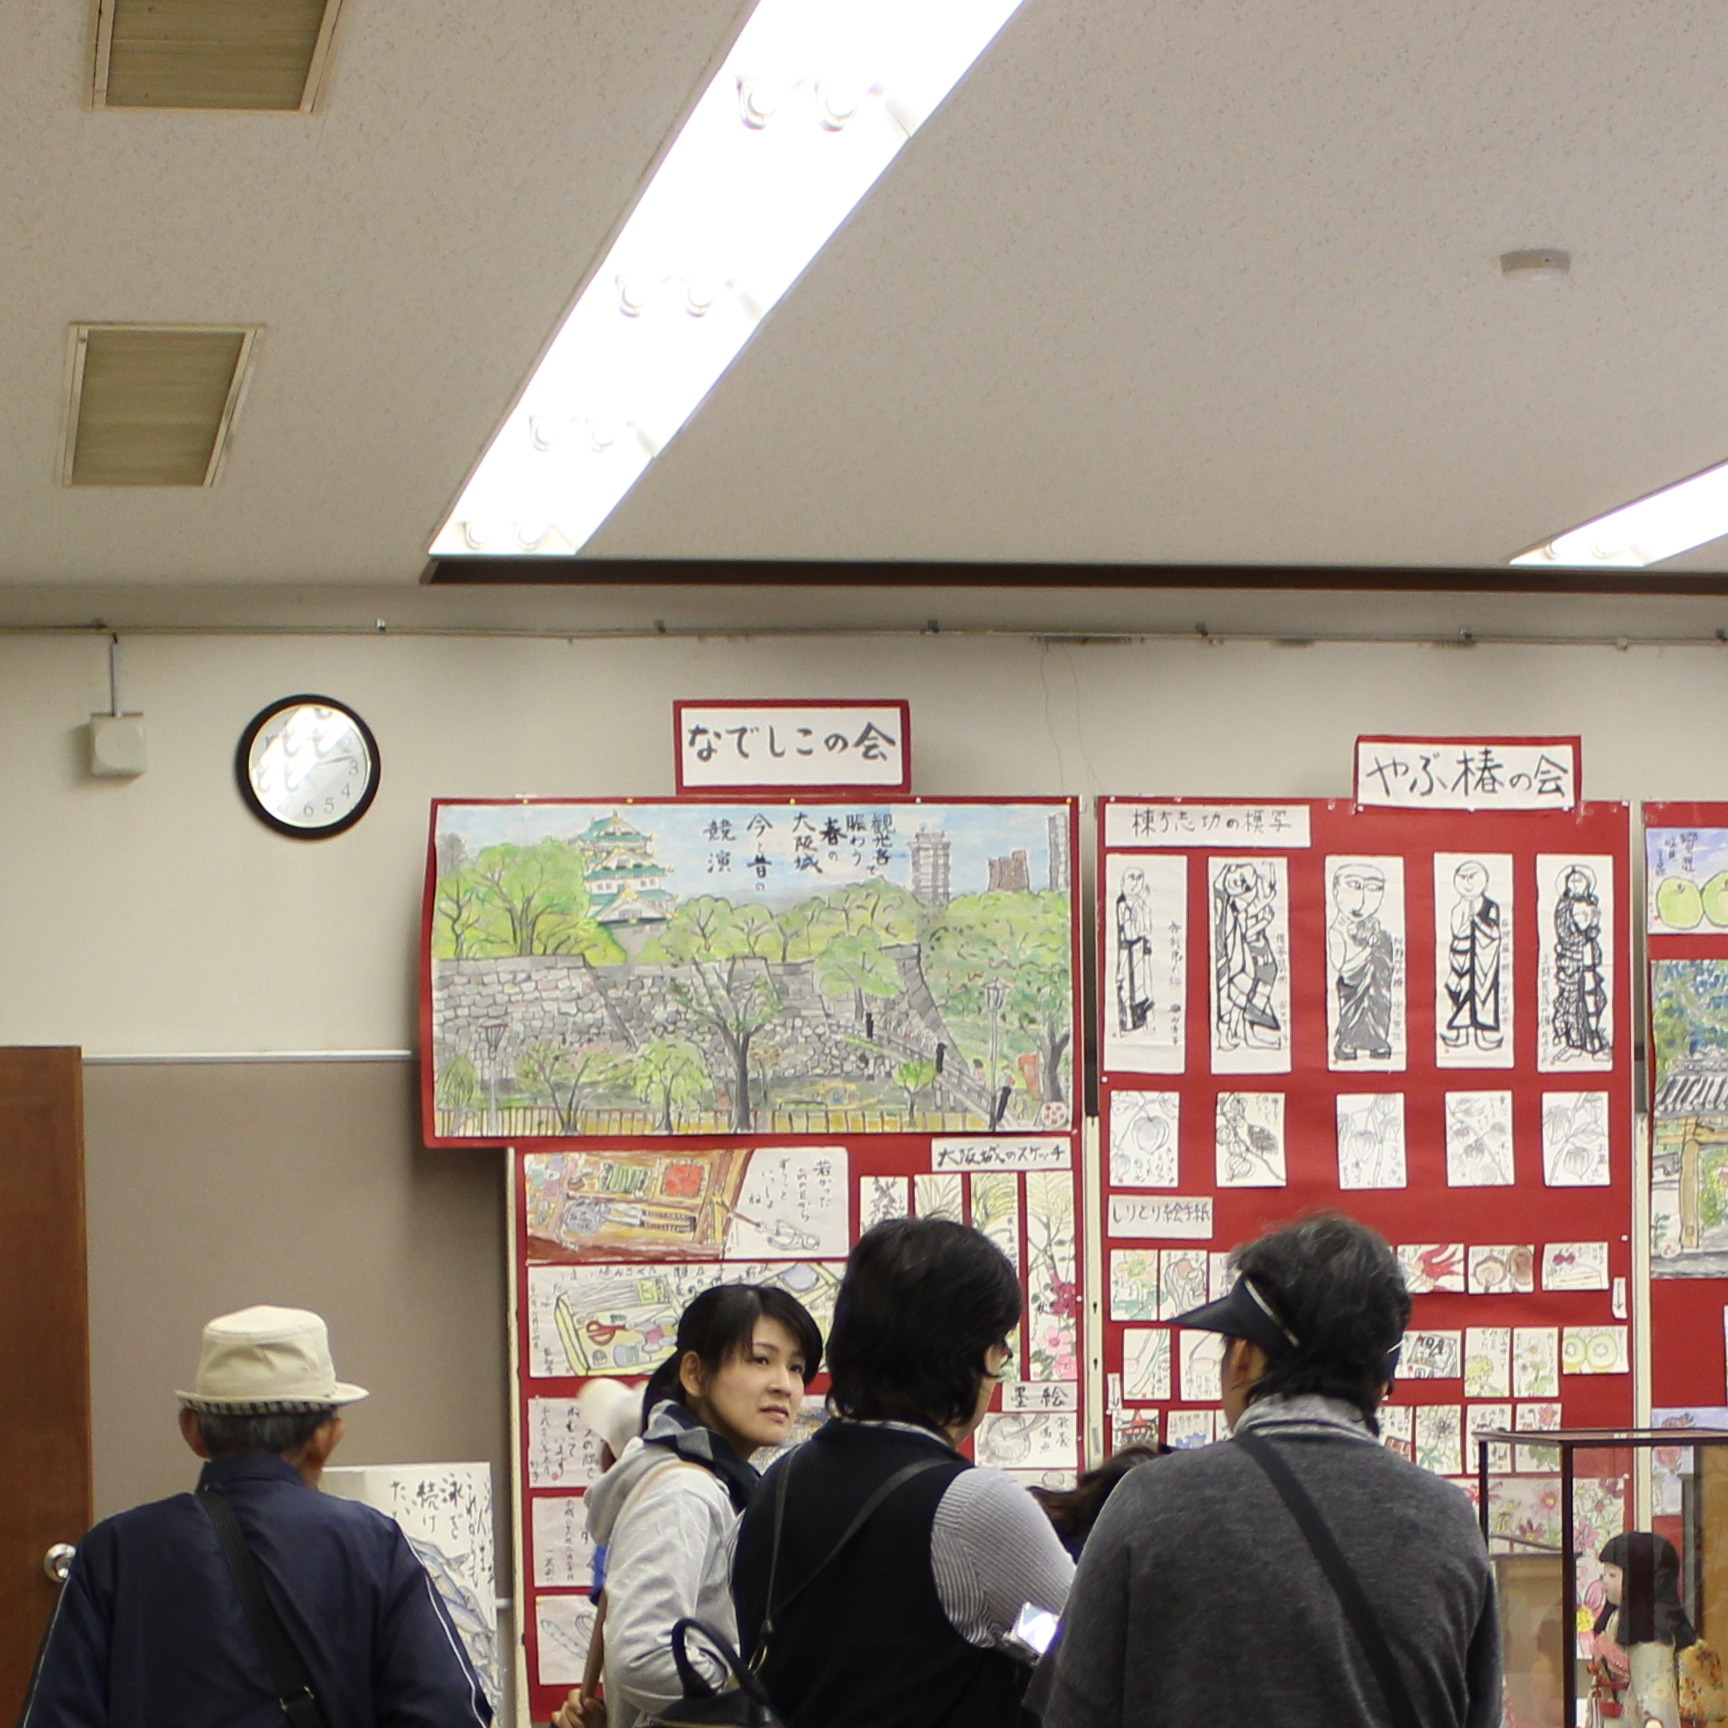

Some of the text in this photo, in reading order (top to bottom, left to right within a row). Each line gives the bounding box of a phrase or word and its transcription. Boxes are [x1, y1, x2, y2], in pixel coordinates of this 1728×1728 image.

[688, 721, 897, 765] なでしこの会
[1366, 749, 1569, 798] やぶ椿の会
[790, 811, 824, 875] 大阪城
[819, 816, 849, 863] 春の
[1131, 807, 1292, 838] 棟方志功の模写
[745, 812, 774, 892] 今と昔の
[937, 1142, 1066, 1169] 大阪城のスケッチ
[1112, 1201, 1211, 1225] しりとり絵手紙
[1010, 1384, 1069, 1409] 墨絵
[439, 1472, 465, 1541] 泳ぎ
